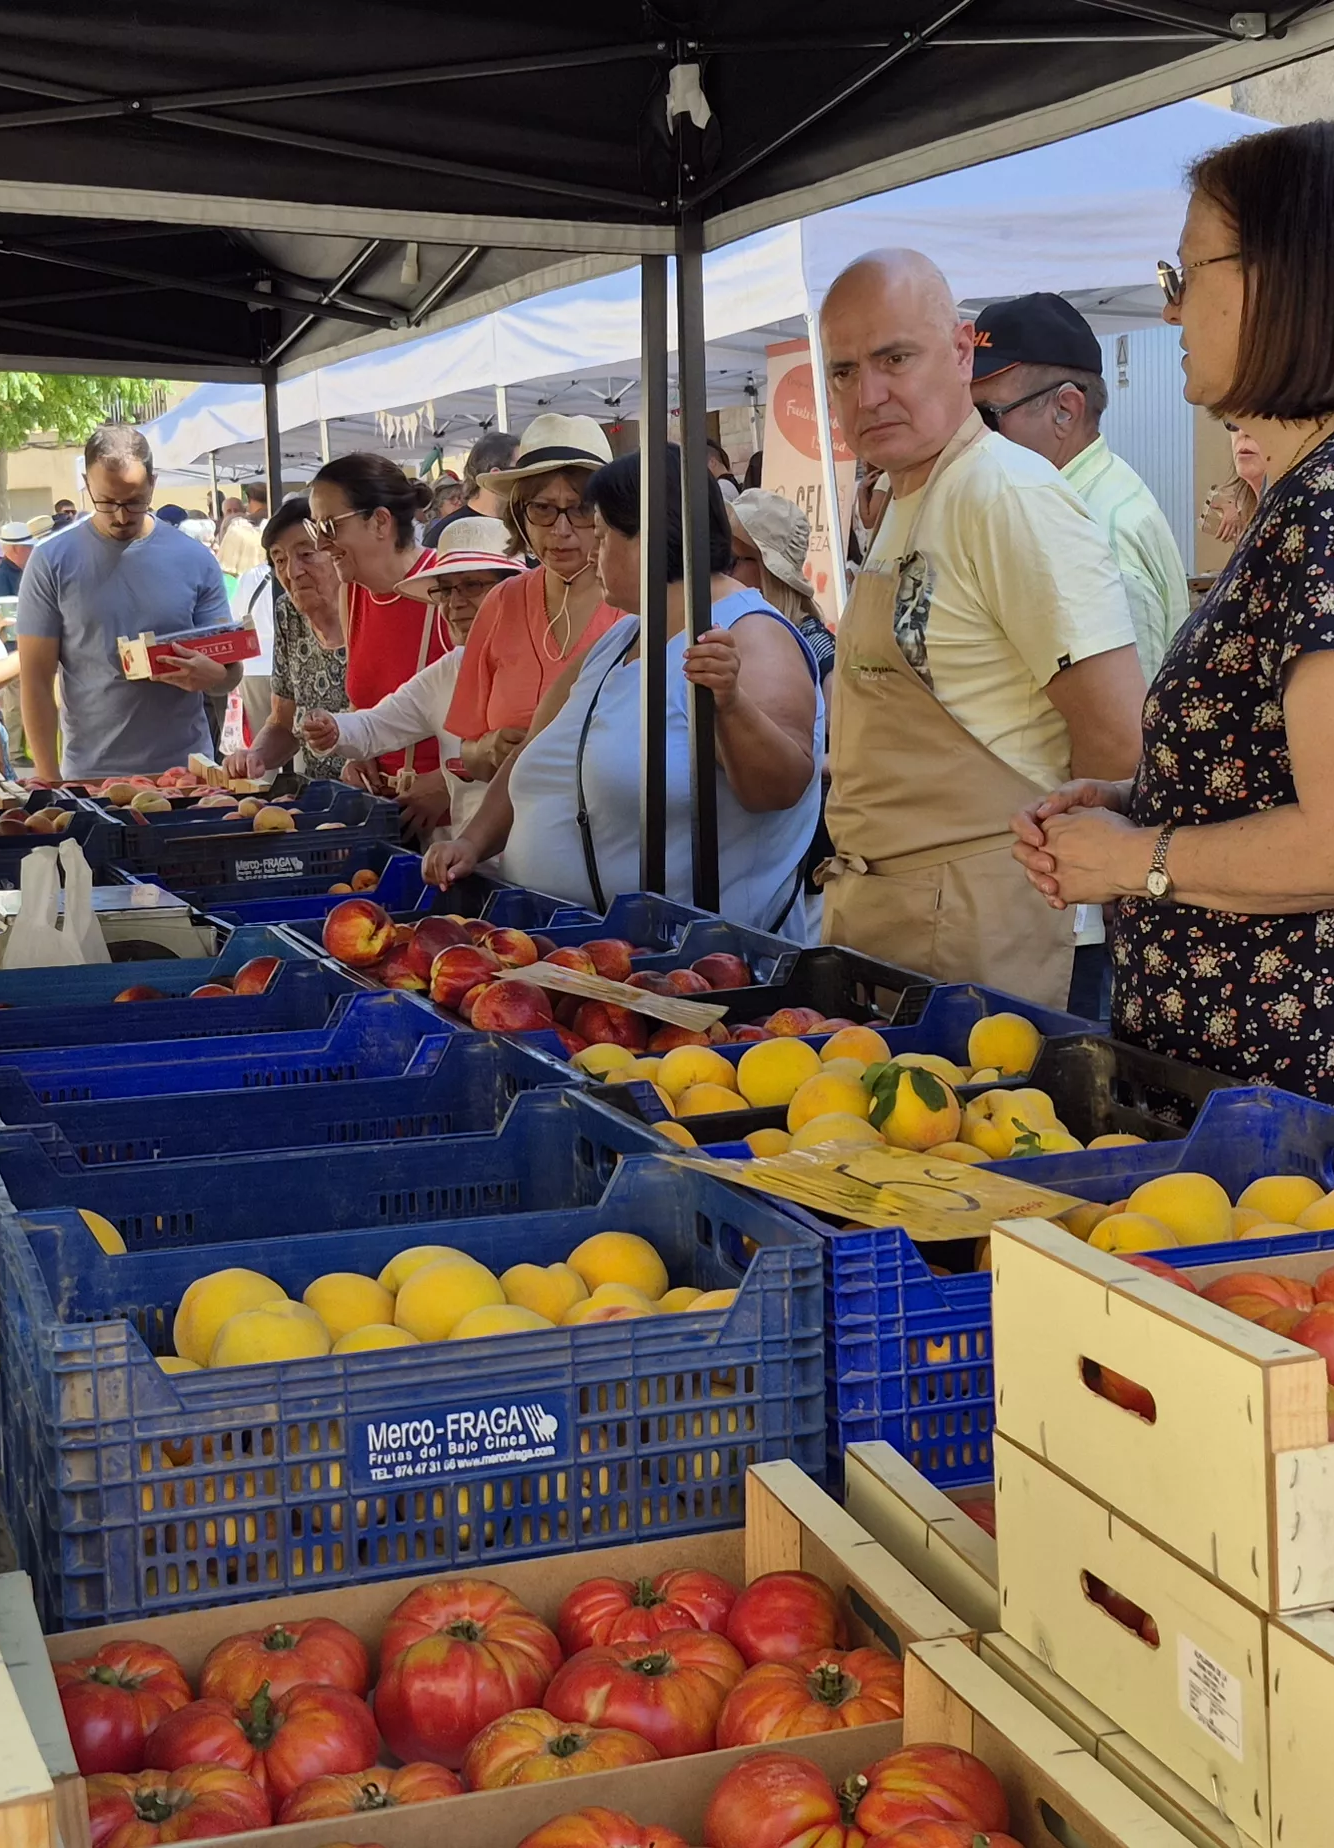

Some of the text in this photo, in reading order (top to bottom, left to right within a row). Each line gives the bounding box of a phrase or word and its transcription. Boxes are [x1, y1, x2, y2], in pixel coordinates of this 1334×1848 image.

[368, 1405, 523, 1452] Merco-FRAGA
[369, 1433, 527, 1466] Frutas del Bajo Cinca
[394, 1463, 414, 1478] 974
[414, 1462, 427, 1474] 47
[429, 1461, 441, 1473] 31
